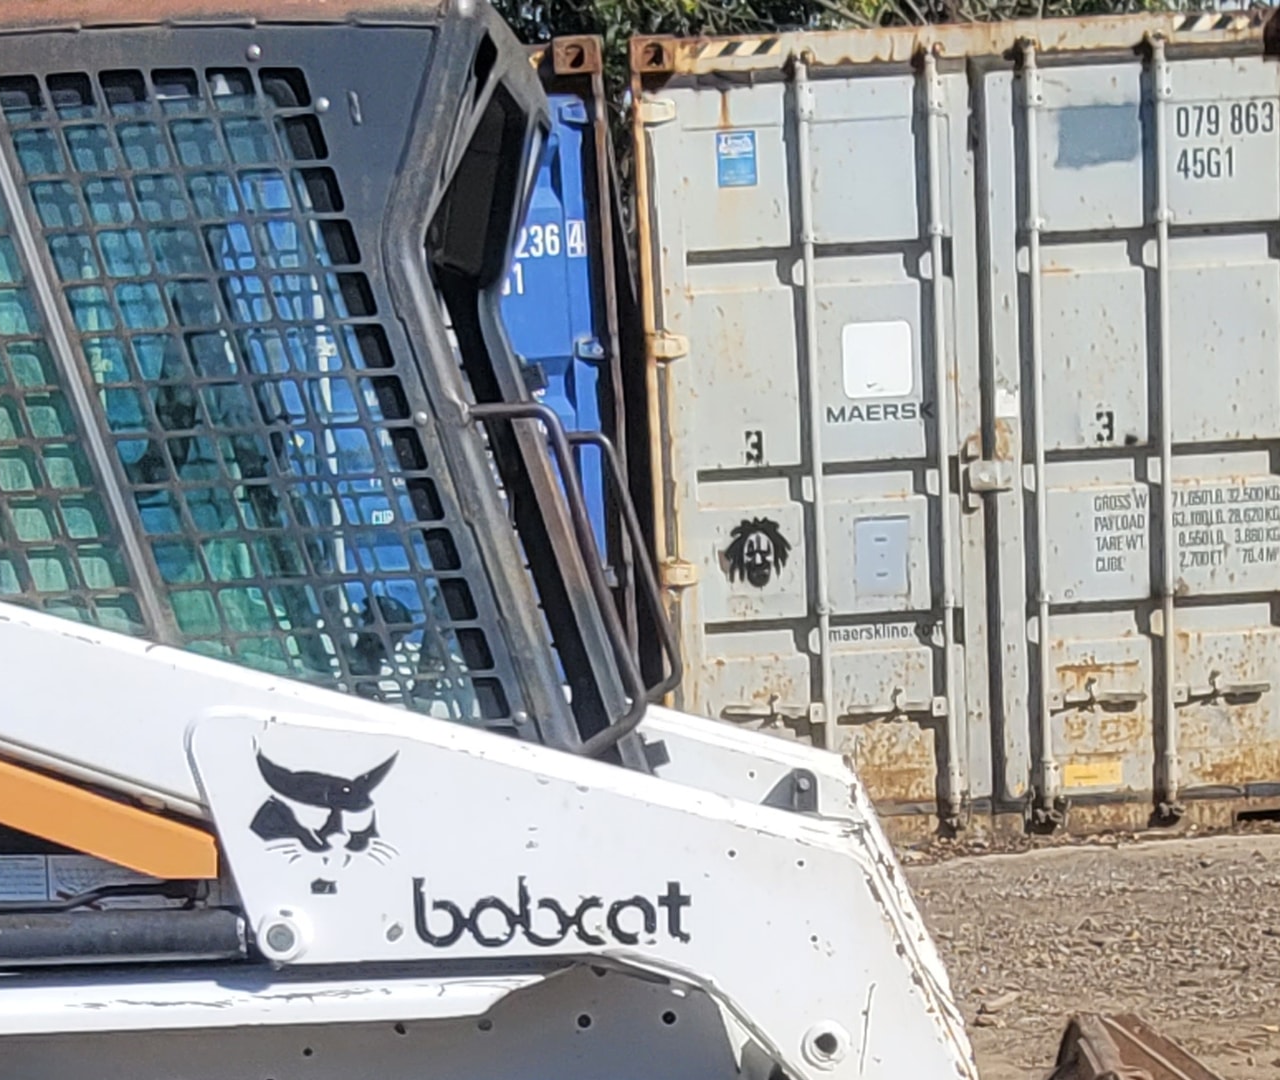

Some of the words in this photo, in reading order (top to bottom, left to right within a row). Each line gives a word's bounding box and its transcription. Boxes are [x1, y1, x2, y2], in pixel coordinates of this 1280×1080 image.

[1177, 105, 1220, 138] 079
[1230, 102, 1274, 135] 863
[1177, 146, 1234, 179] 45G1
[570, 225, 583, 255] 4
[827, 403, 934, 423] MAERSK
[1095, 411, 1114, 442] 3
[1094, 494, 1131, 512] GROSS
[1094, 514, 1145, 532] PAYLOAD
[1096, 536, 1123, 552] TARE
[1096, 556, 1125, 572] CUBE
[413, 875, 692, 947] bobcat
